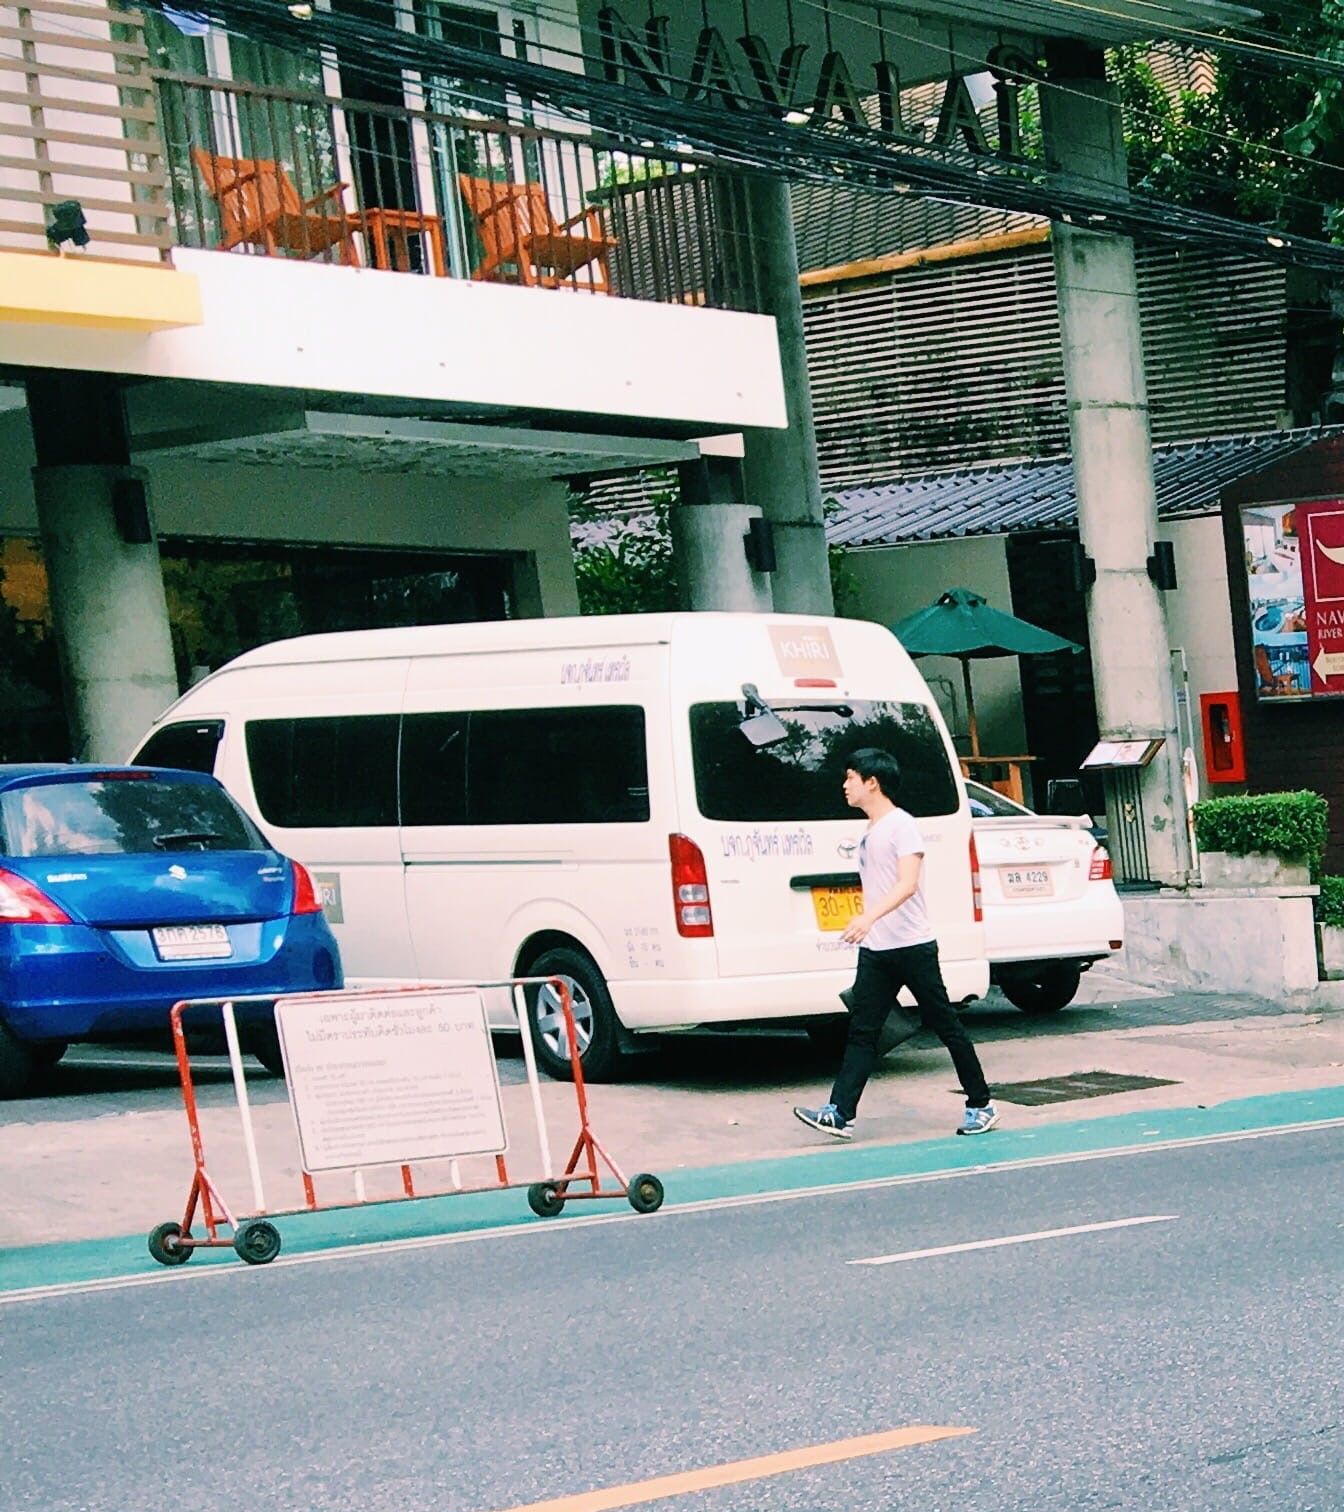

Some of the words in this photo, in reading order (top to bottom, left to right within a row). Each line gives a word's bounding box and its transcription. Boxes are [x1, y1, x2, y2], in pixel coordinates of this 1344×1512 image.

[599, 6, 1042, 158] NAVALAI
[1318, 627, 1343, 639] RIVER
[780, 639, 830, 660] KHIRI
